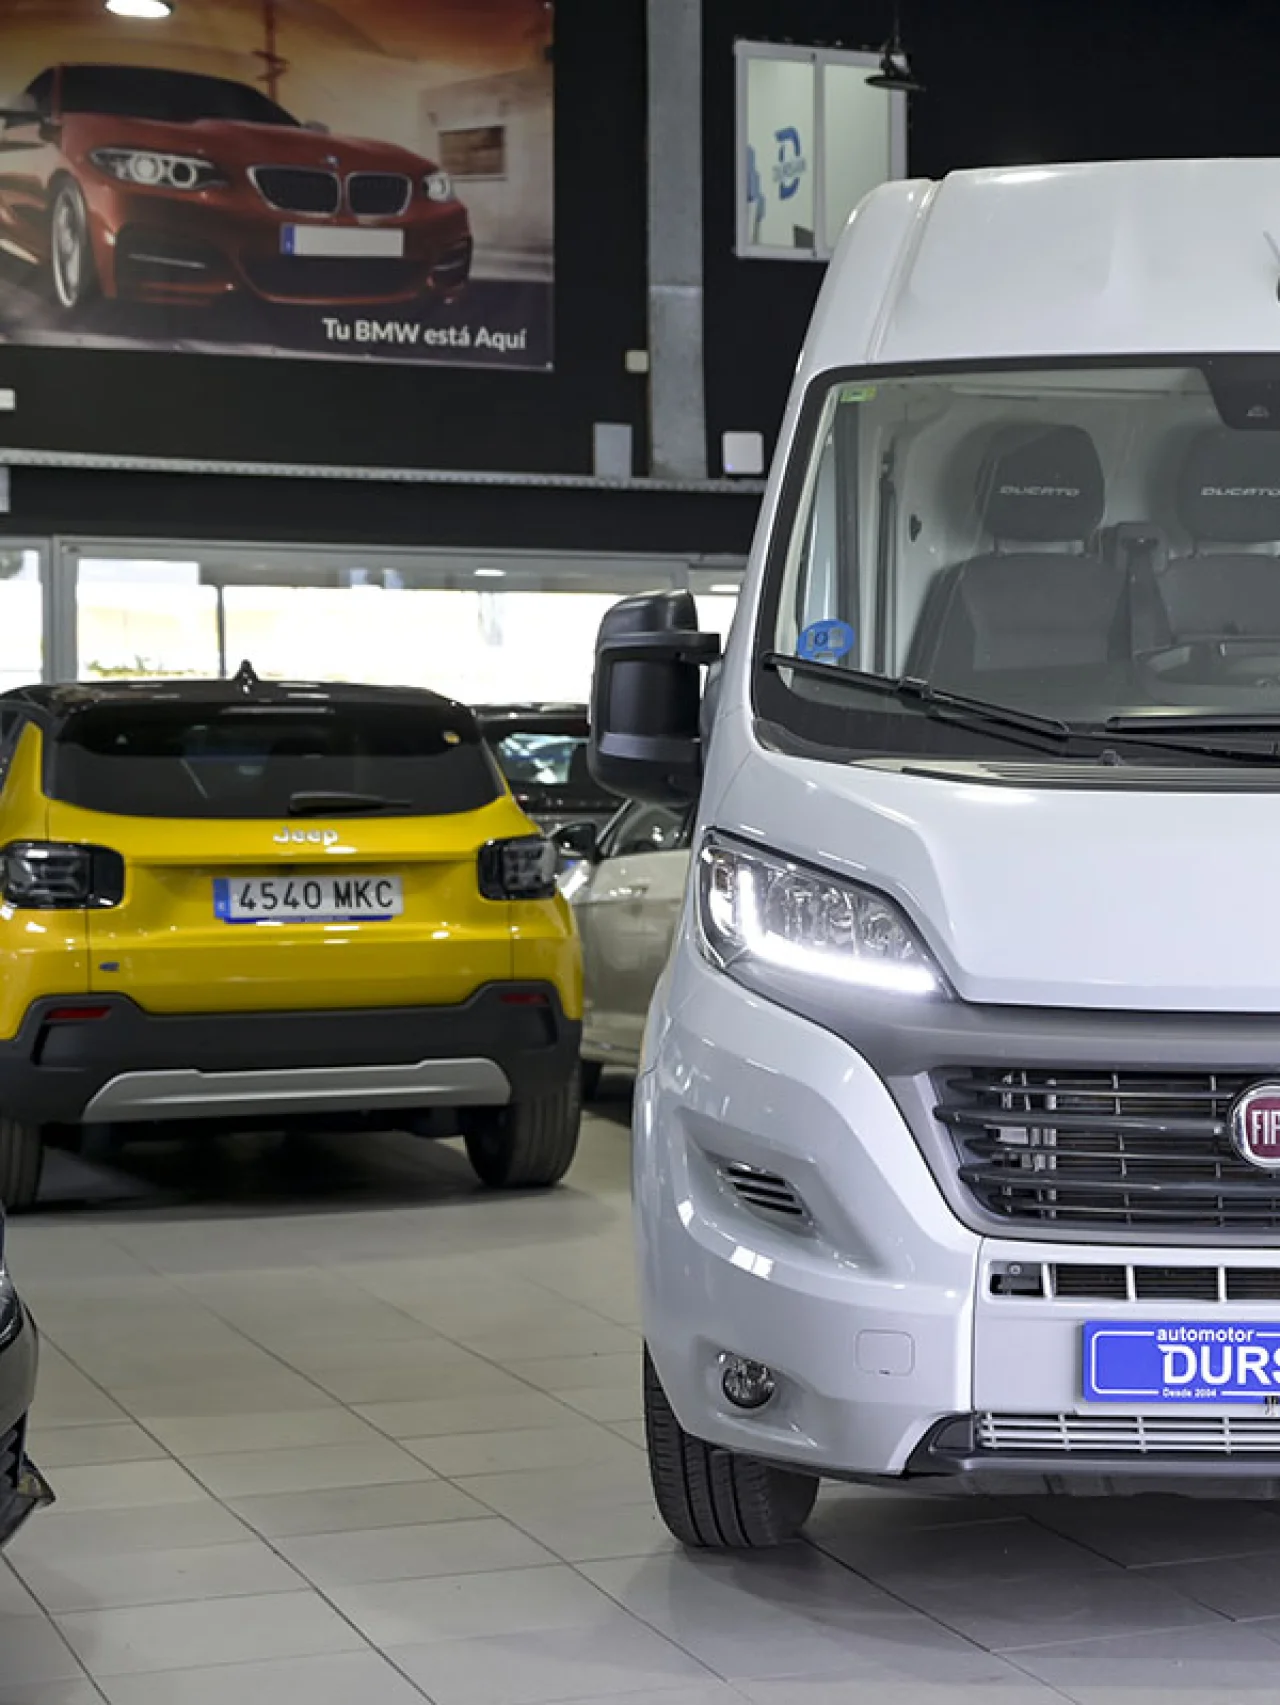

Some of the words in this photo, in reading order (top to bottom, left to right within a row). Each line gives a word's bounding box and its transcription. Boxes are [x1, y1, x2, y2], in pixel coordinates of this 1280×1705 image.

[322, 317, 350, 340] Tu
[354, 319, 420, 344] BMW
[423, 324, 470, 347] está
[475, 325, 527, 352] Aquí
[999, 485, 1080, 498] DUCATO
[272, 826, 339, 846] Jeep
[238, 880, 322, 911] 4540
[333, 879, 394, 909] MKC
[1155, 1326, 1255, 1343] automotor
